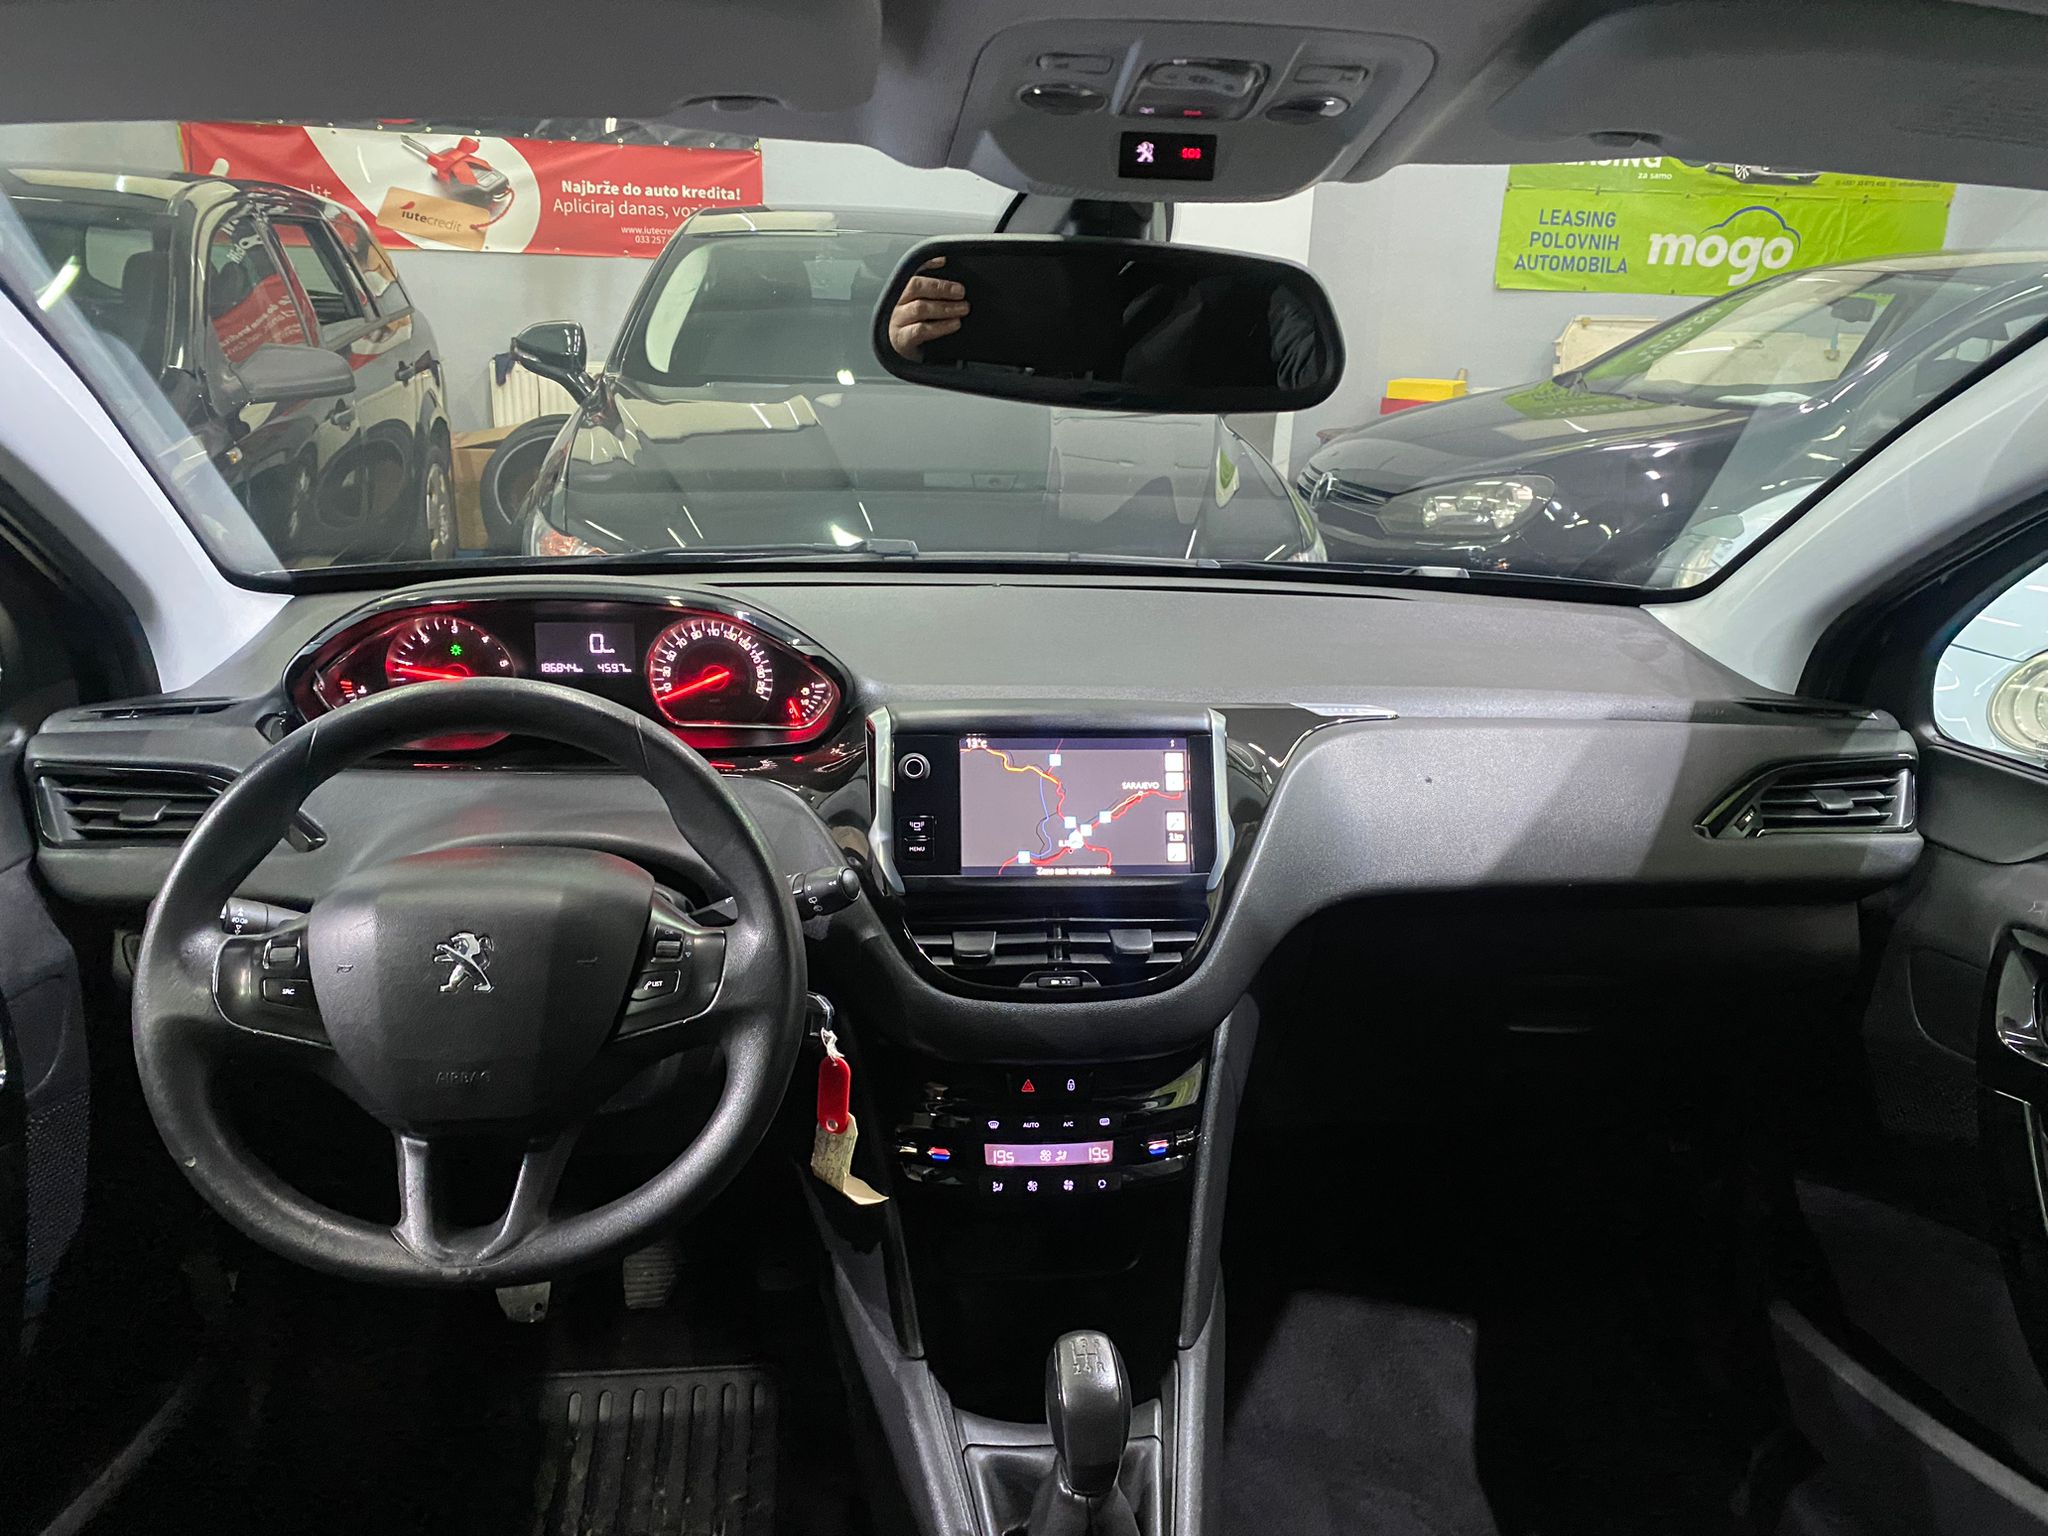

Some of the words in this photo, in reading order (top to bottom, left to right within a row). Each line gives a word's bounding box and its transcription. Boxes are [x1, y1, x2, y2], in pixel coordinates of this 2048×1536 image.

[1638, 172, 1648, 180] za
[1650, 173, 1673, 181] samo
[561, 180, 620, 197] Najbrže
[622, 182, 641, 196] do
[645, 184, 679, 198] auto
[682, 185, 741, 201] kredita!
[553, 198, 615, 218] Apliciraj
[618, 200, 669, 219] danas,
[1538, 208, 1617, 228] LEASING
[401, 207, 462, 233] iutecredit
[635, 235, 650, 244] 033
[651, 236, 666, 244] 257
[1529, 231, 1620, 251] POLOVNIH
[1514, 254, 1628, 274] AUTOMOBILA
[1647, 233, 1794, 286] mogo
[1121, 782, 1160, 790] SARAJEVO
